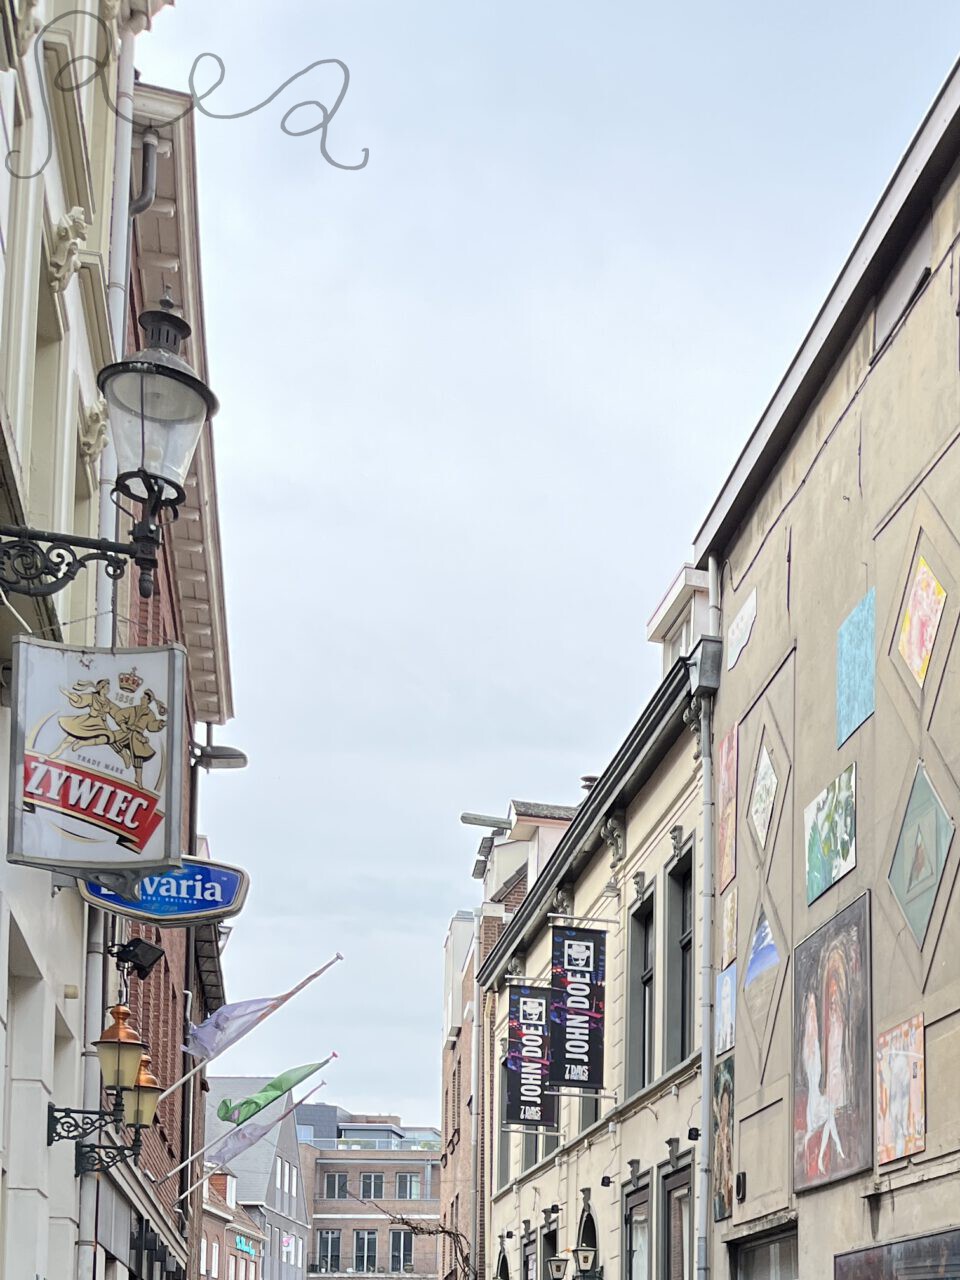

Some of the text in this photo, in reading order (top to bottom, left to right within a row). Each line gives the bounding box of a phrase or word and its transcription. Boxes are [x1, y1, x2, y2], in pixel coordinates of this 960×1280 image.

[25, 757, 148, 829] ŻYWIEC
[101, 874, 223, 902] varia
[566, 971, 591, 1009] DOE
[521, 1024, 543, 1057] DOE
[565, 1014, 590, 1063] JOHN
[520, 1062, 542, 1104] JOHN
